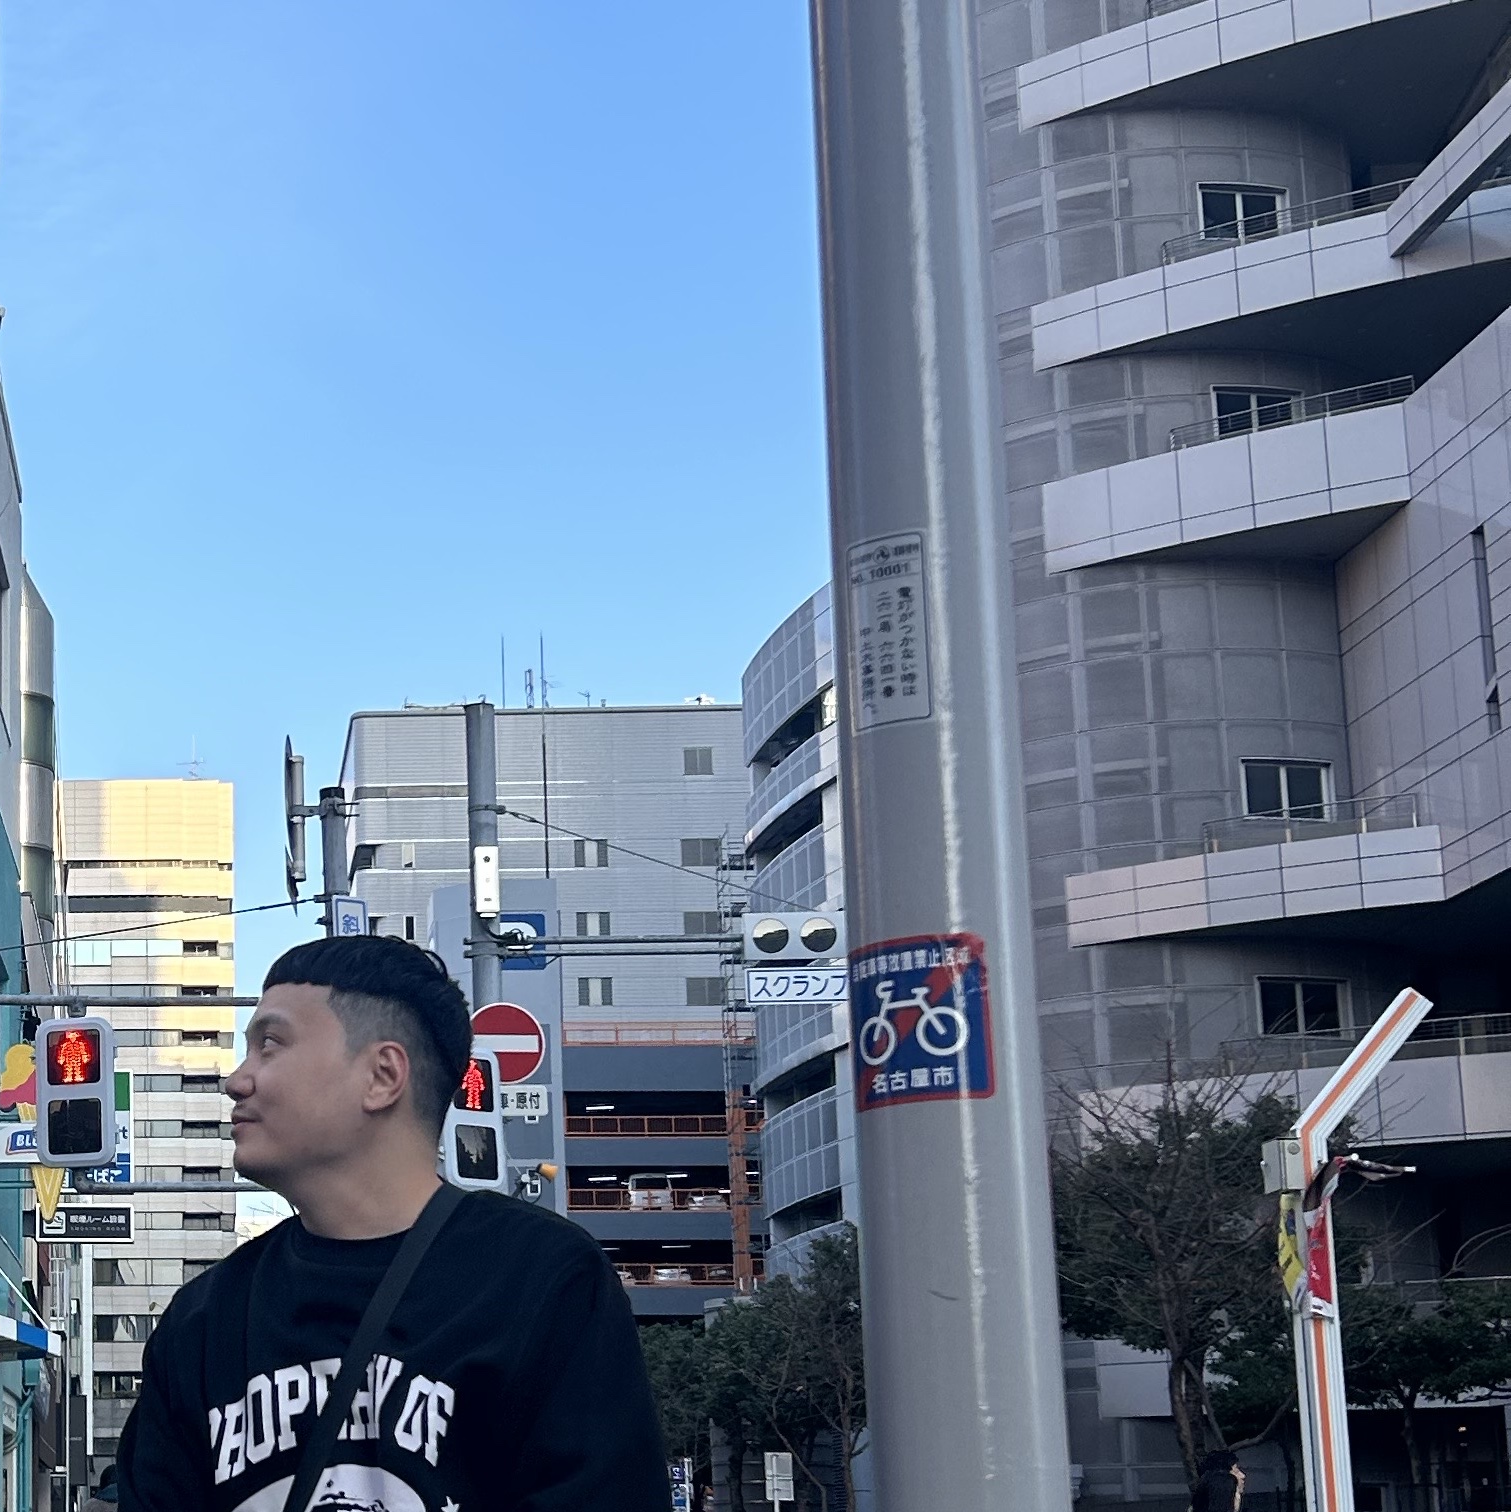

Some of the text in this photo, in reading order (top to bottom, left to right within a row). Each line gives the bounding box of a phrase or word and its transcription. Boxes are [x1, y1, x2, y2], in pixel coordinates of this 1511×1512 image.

[852, 947, 972, 983] 自転車等放置禁止区域
[871, 1066, 956, 1095] 名古屋市
[393, 1374, 455, 1467] OF
